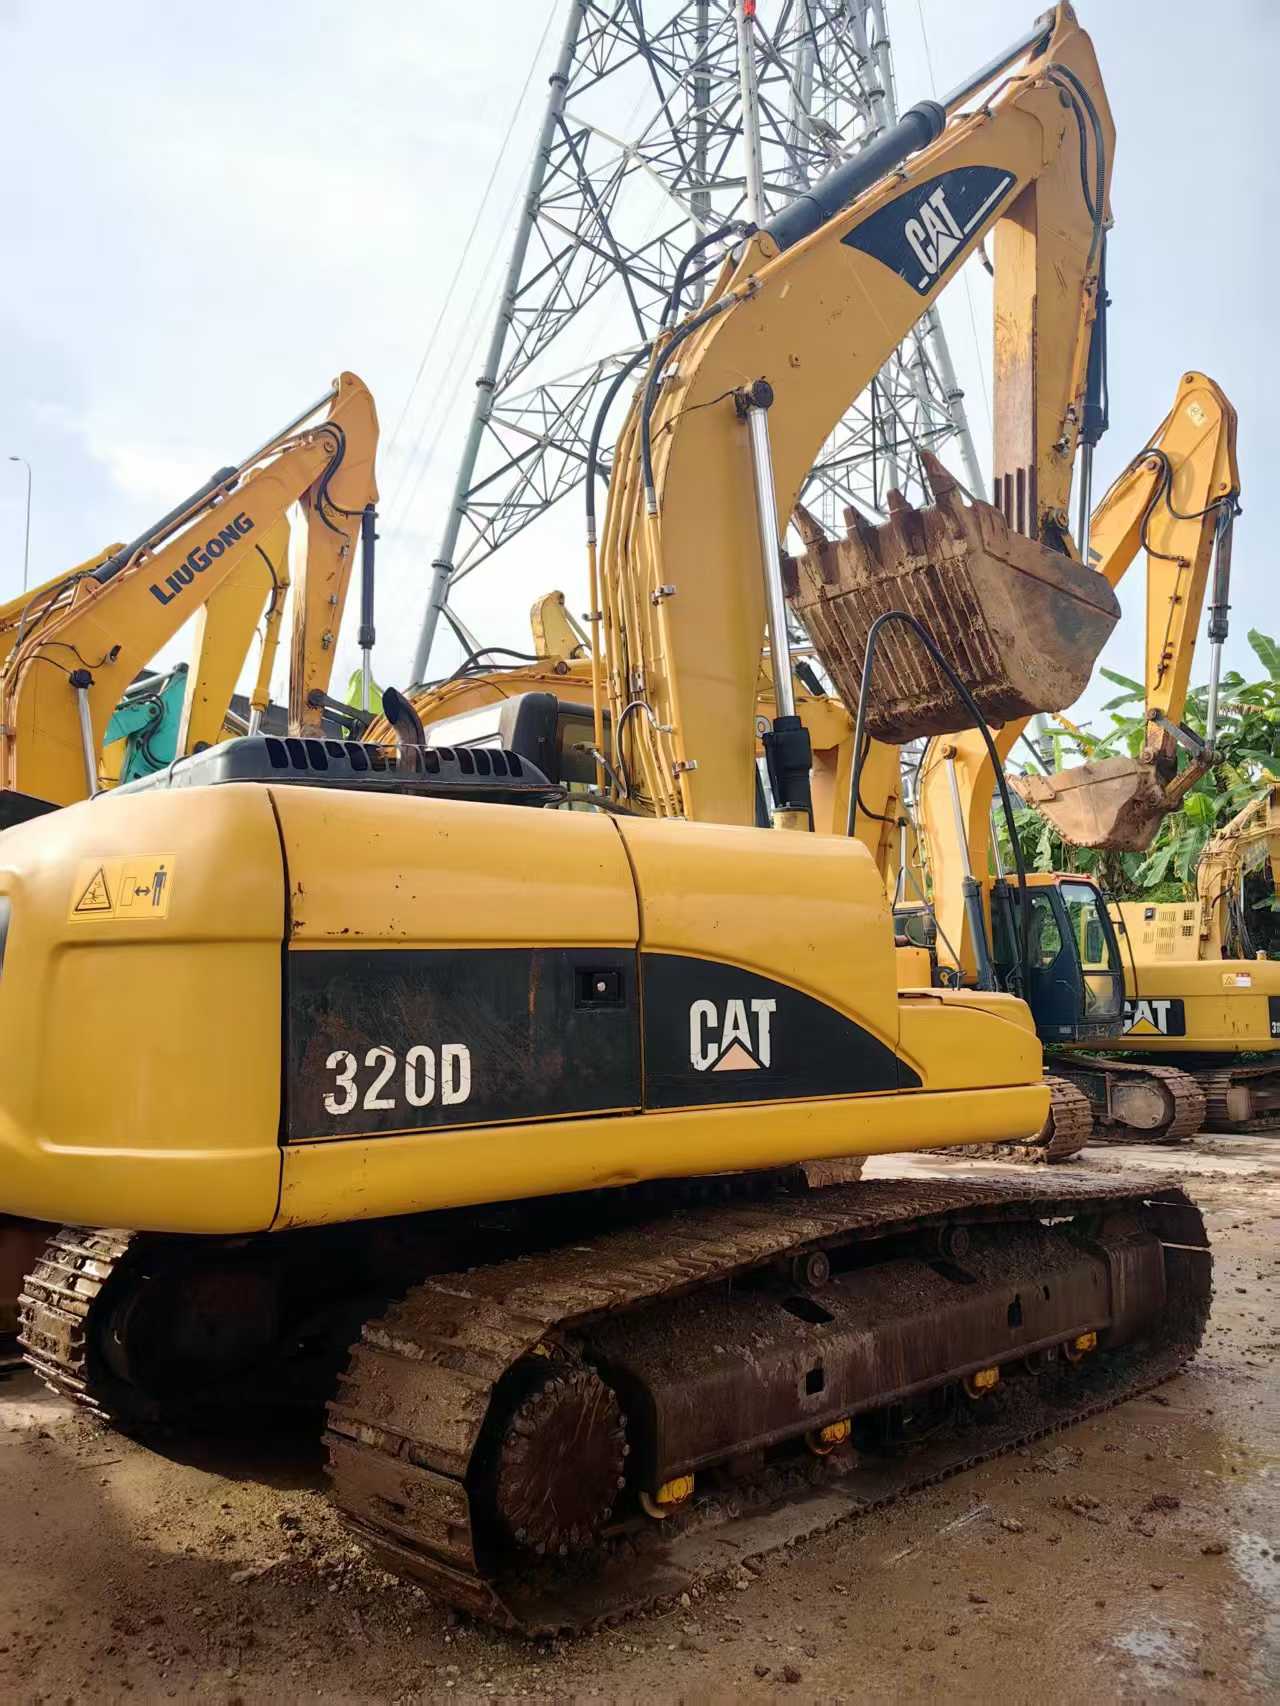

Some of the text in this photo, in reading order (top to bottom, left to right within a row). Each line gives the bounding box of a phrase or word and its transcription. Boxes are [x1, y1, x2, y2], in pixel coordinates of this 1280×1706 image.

[904, 185, 964, 274] CAT
[690, 998, 777, 1071] CAT
[323, 1043, 471, 1115] 320D
